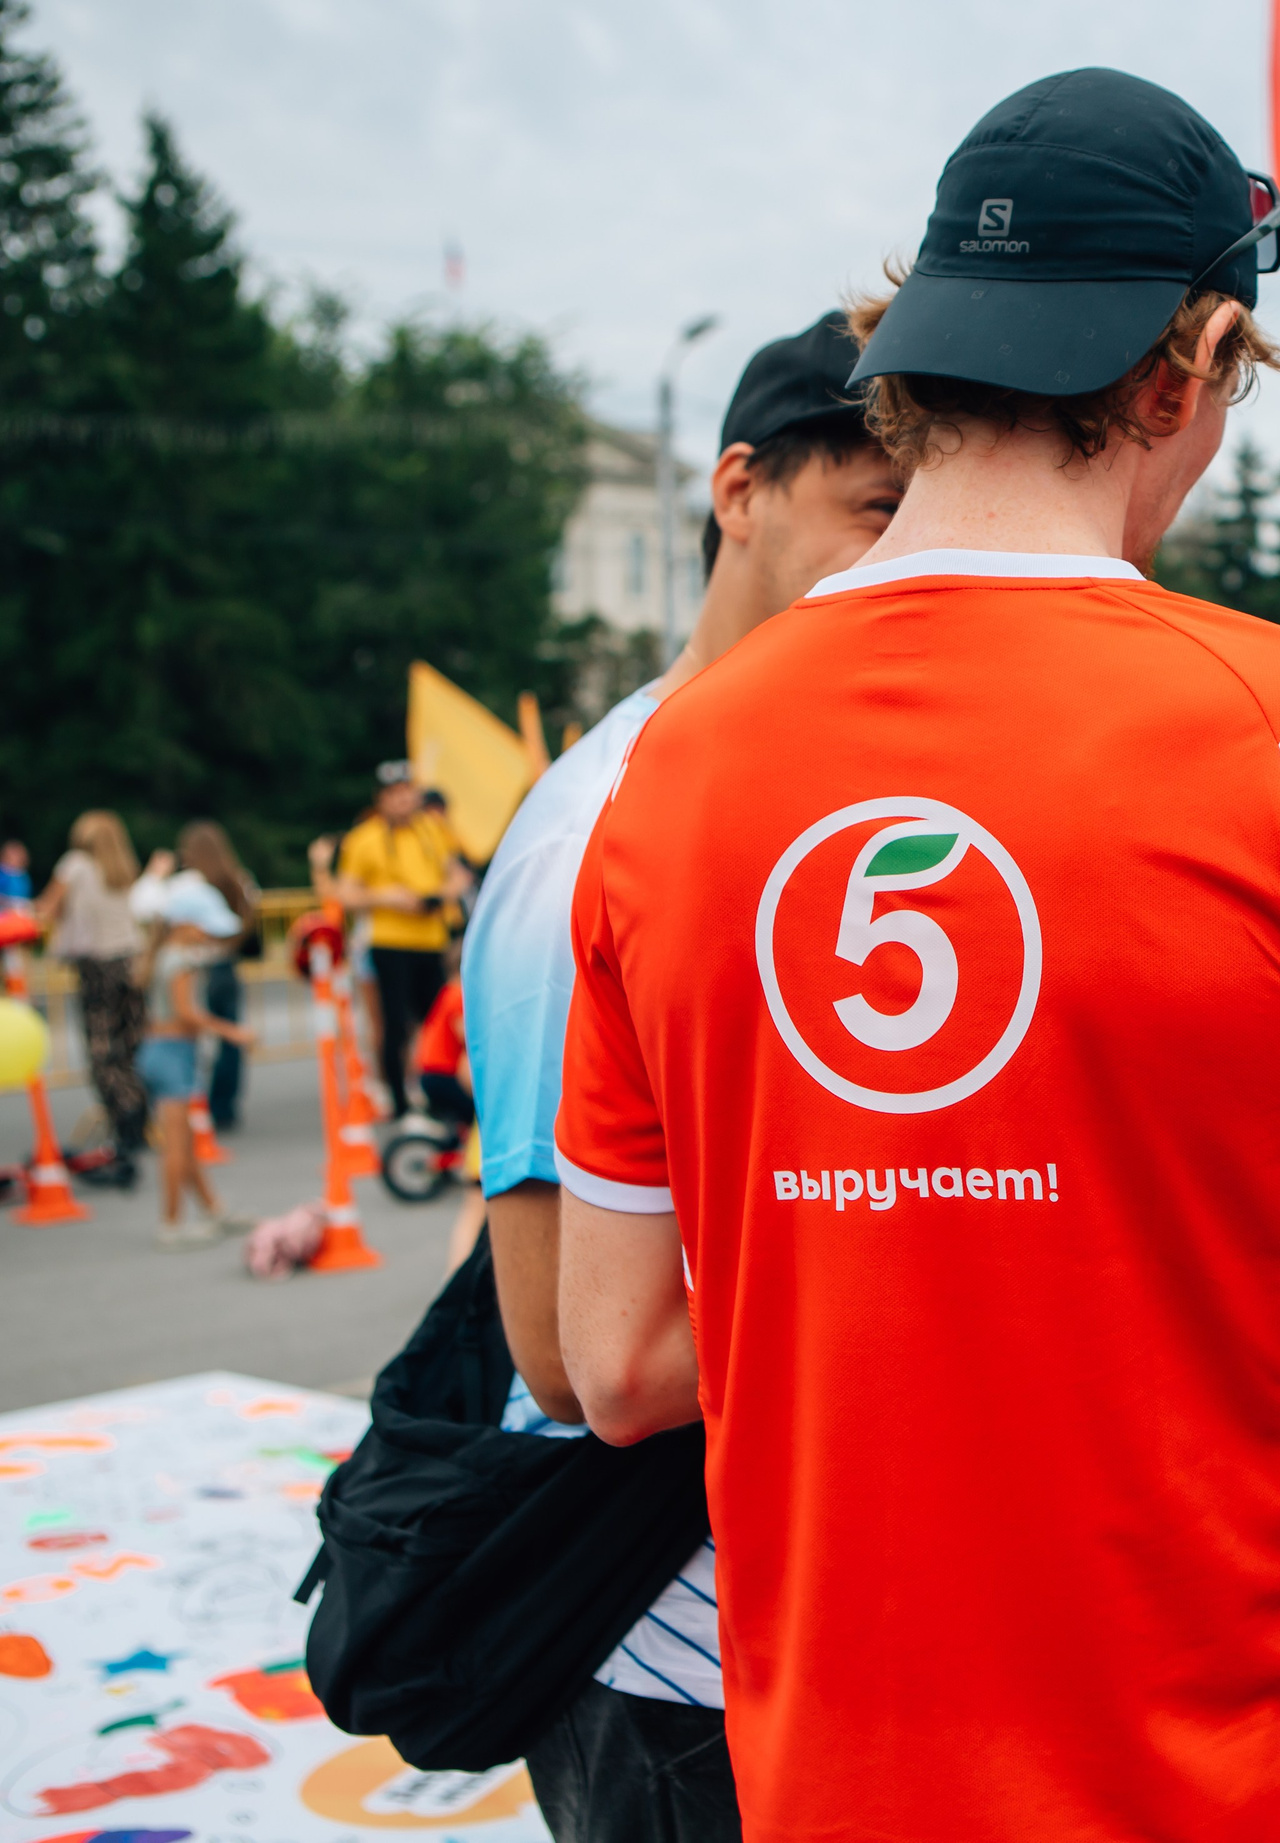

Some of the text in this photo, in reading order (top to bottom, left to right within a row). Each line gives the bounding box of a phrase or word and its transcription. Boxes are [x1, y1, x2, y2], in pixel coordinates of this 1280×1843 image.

[981, 203, 1009, 231] S
[832, 820, 966, 1052] 5
[772, 1162, 1061, 1212] выручает!
